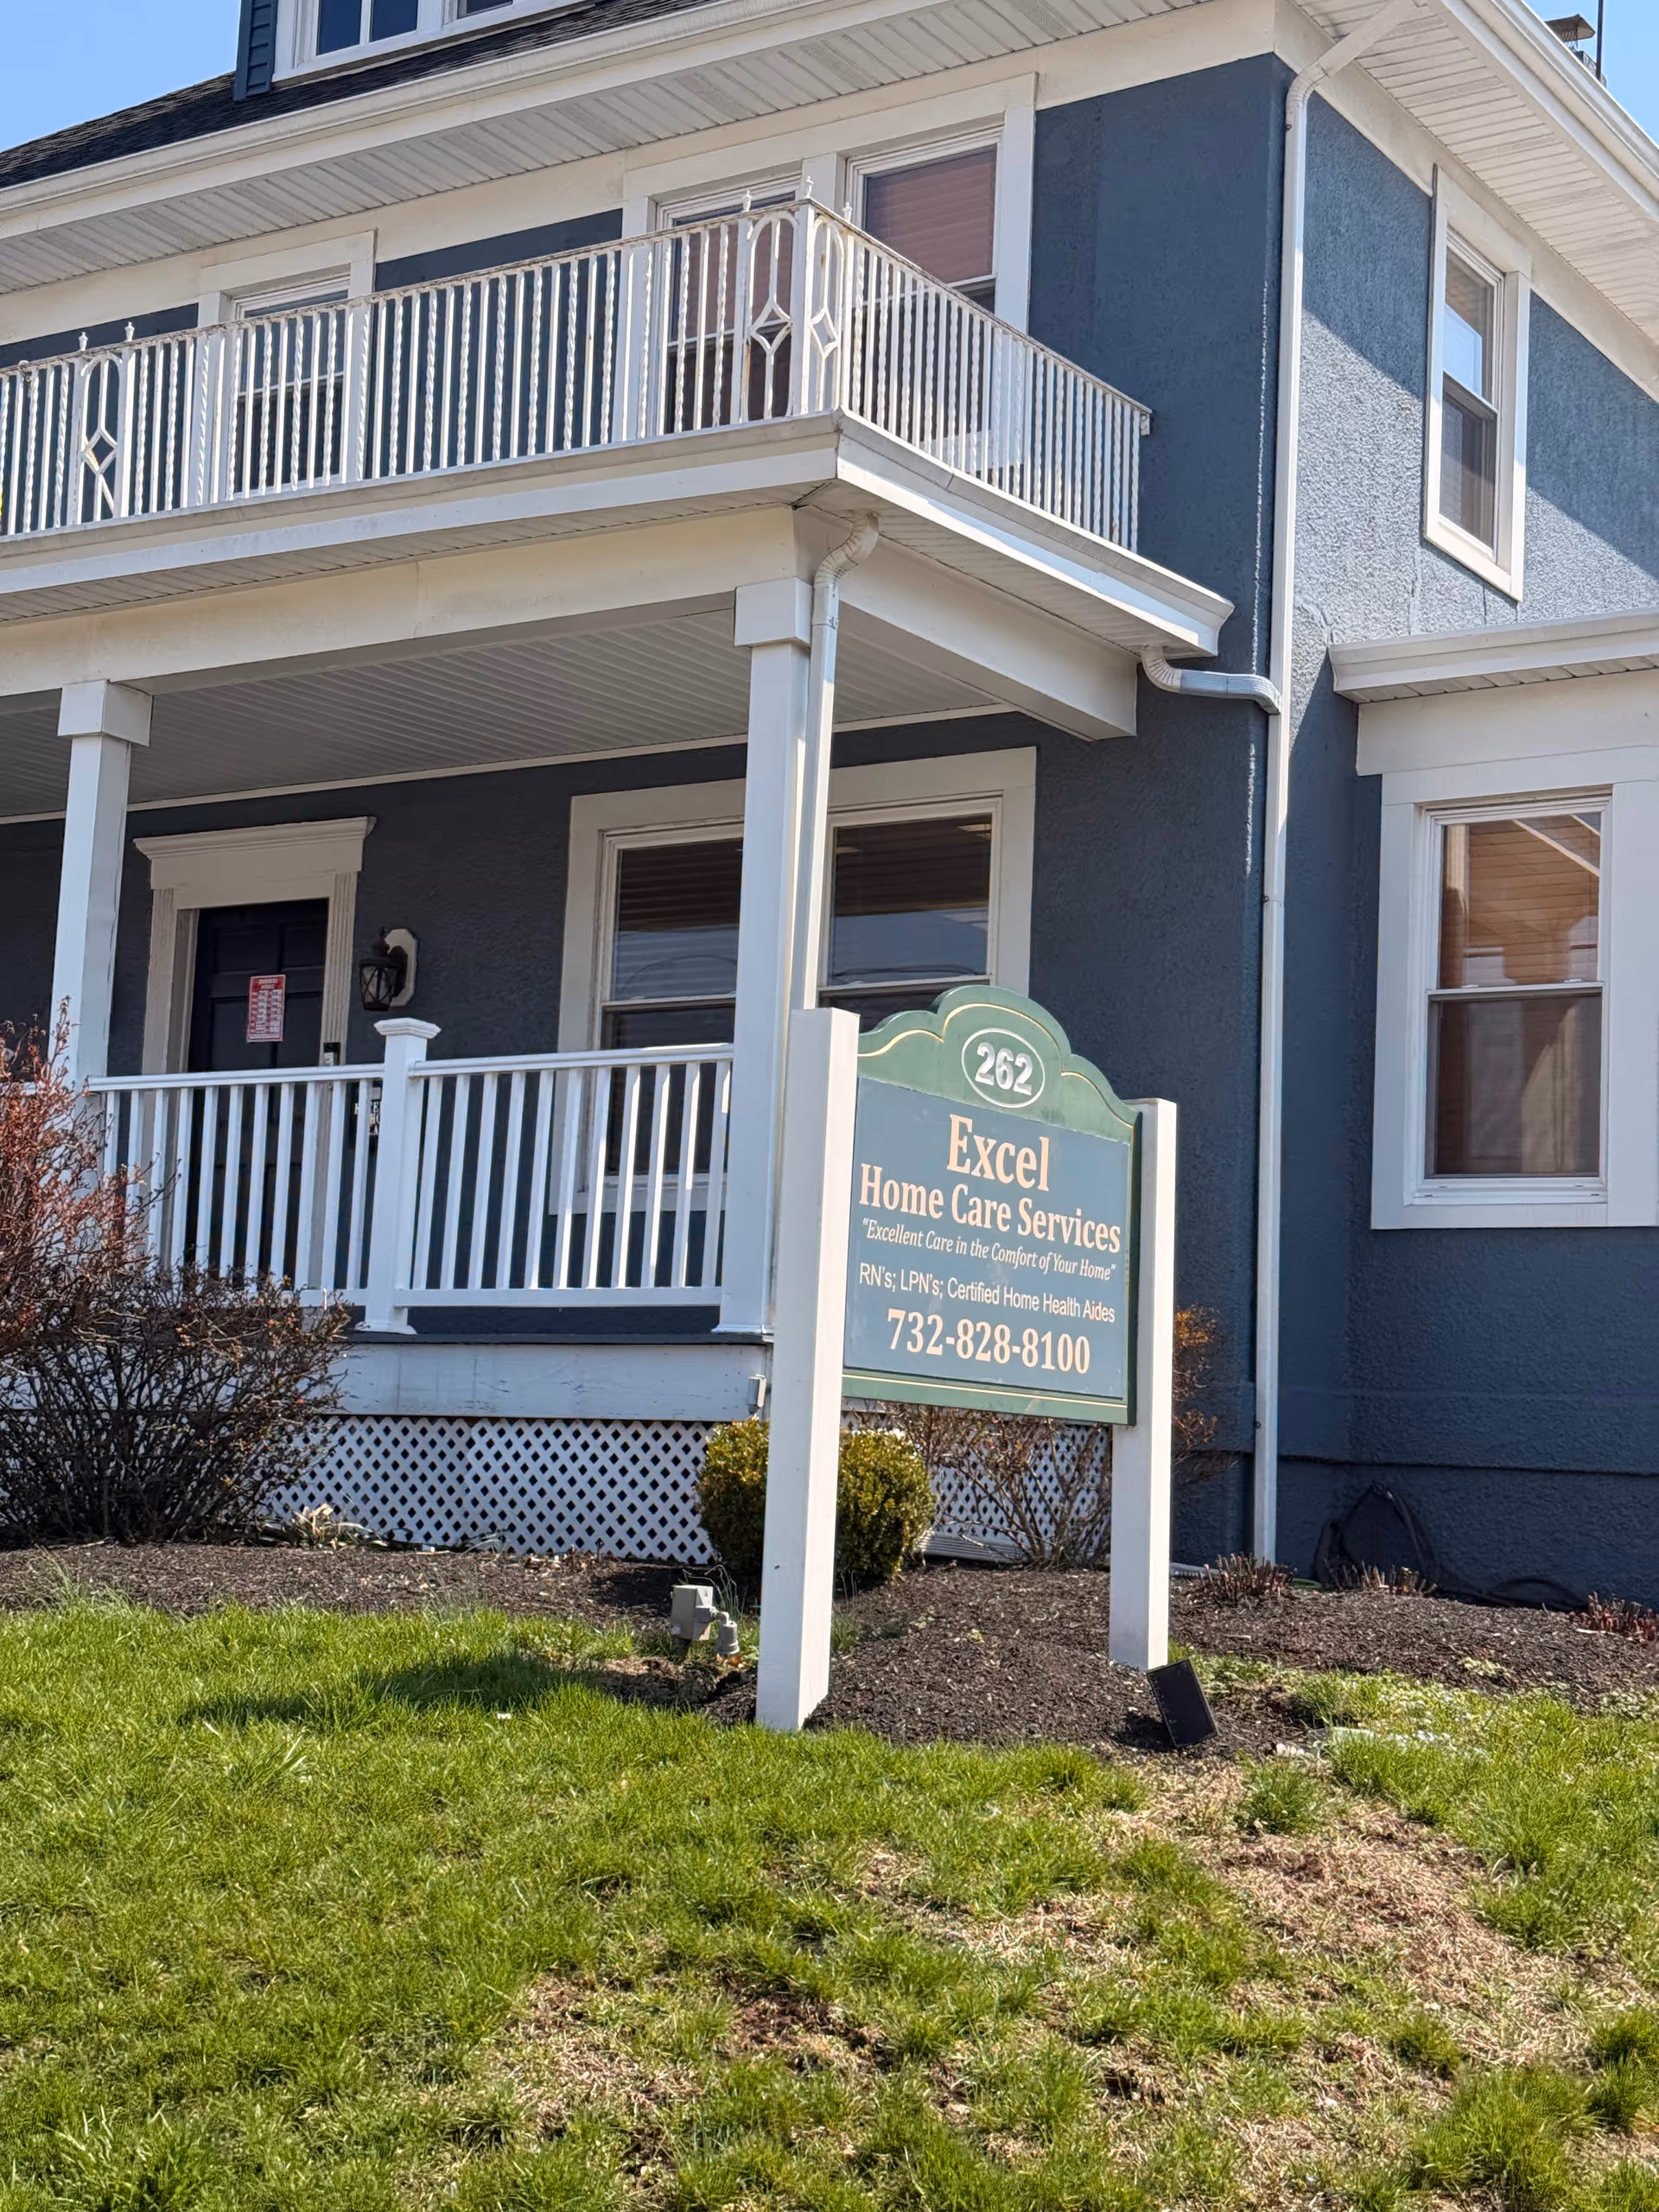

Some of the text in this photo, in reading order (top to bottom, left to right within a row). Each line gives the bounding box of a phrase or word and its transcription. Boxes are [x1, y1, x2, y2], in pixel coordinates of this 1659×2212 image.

[974, 1042, 1033, 1096] 262
[946, 1113, 1050, 1192] Excel
[858, 1162, 1121, 1254] Home Care Services
[925, 1230, 954, 1253] Care
[955, 1236, 968, 1255] in
[969, 1238, 989, 1259] the
[991, 1242, 1039, 1270] Comfort
[1038, 1251, 1053, 1275] of
[1052, 1253, 1078, 1274] Your
[947, 1276, 1001, 1305] Certified
[1003, 1285, 1040, 1312] Home
[1042, 1292, 1081, 1318] Health
[1082, 1299, 1116, 1323] Aides
[887, 1307, 1090, 1375] 732-828-8100
